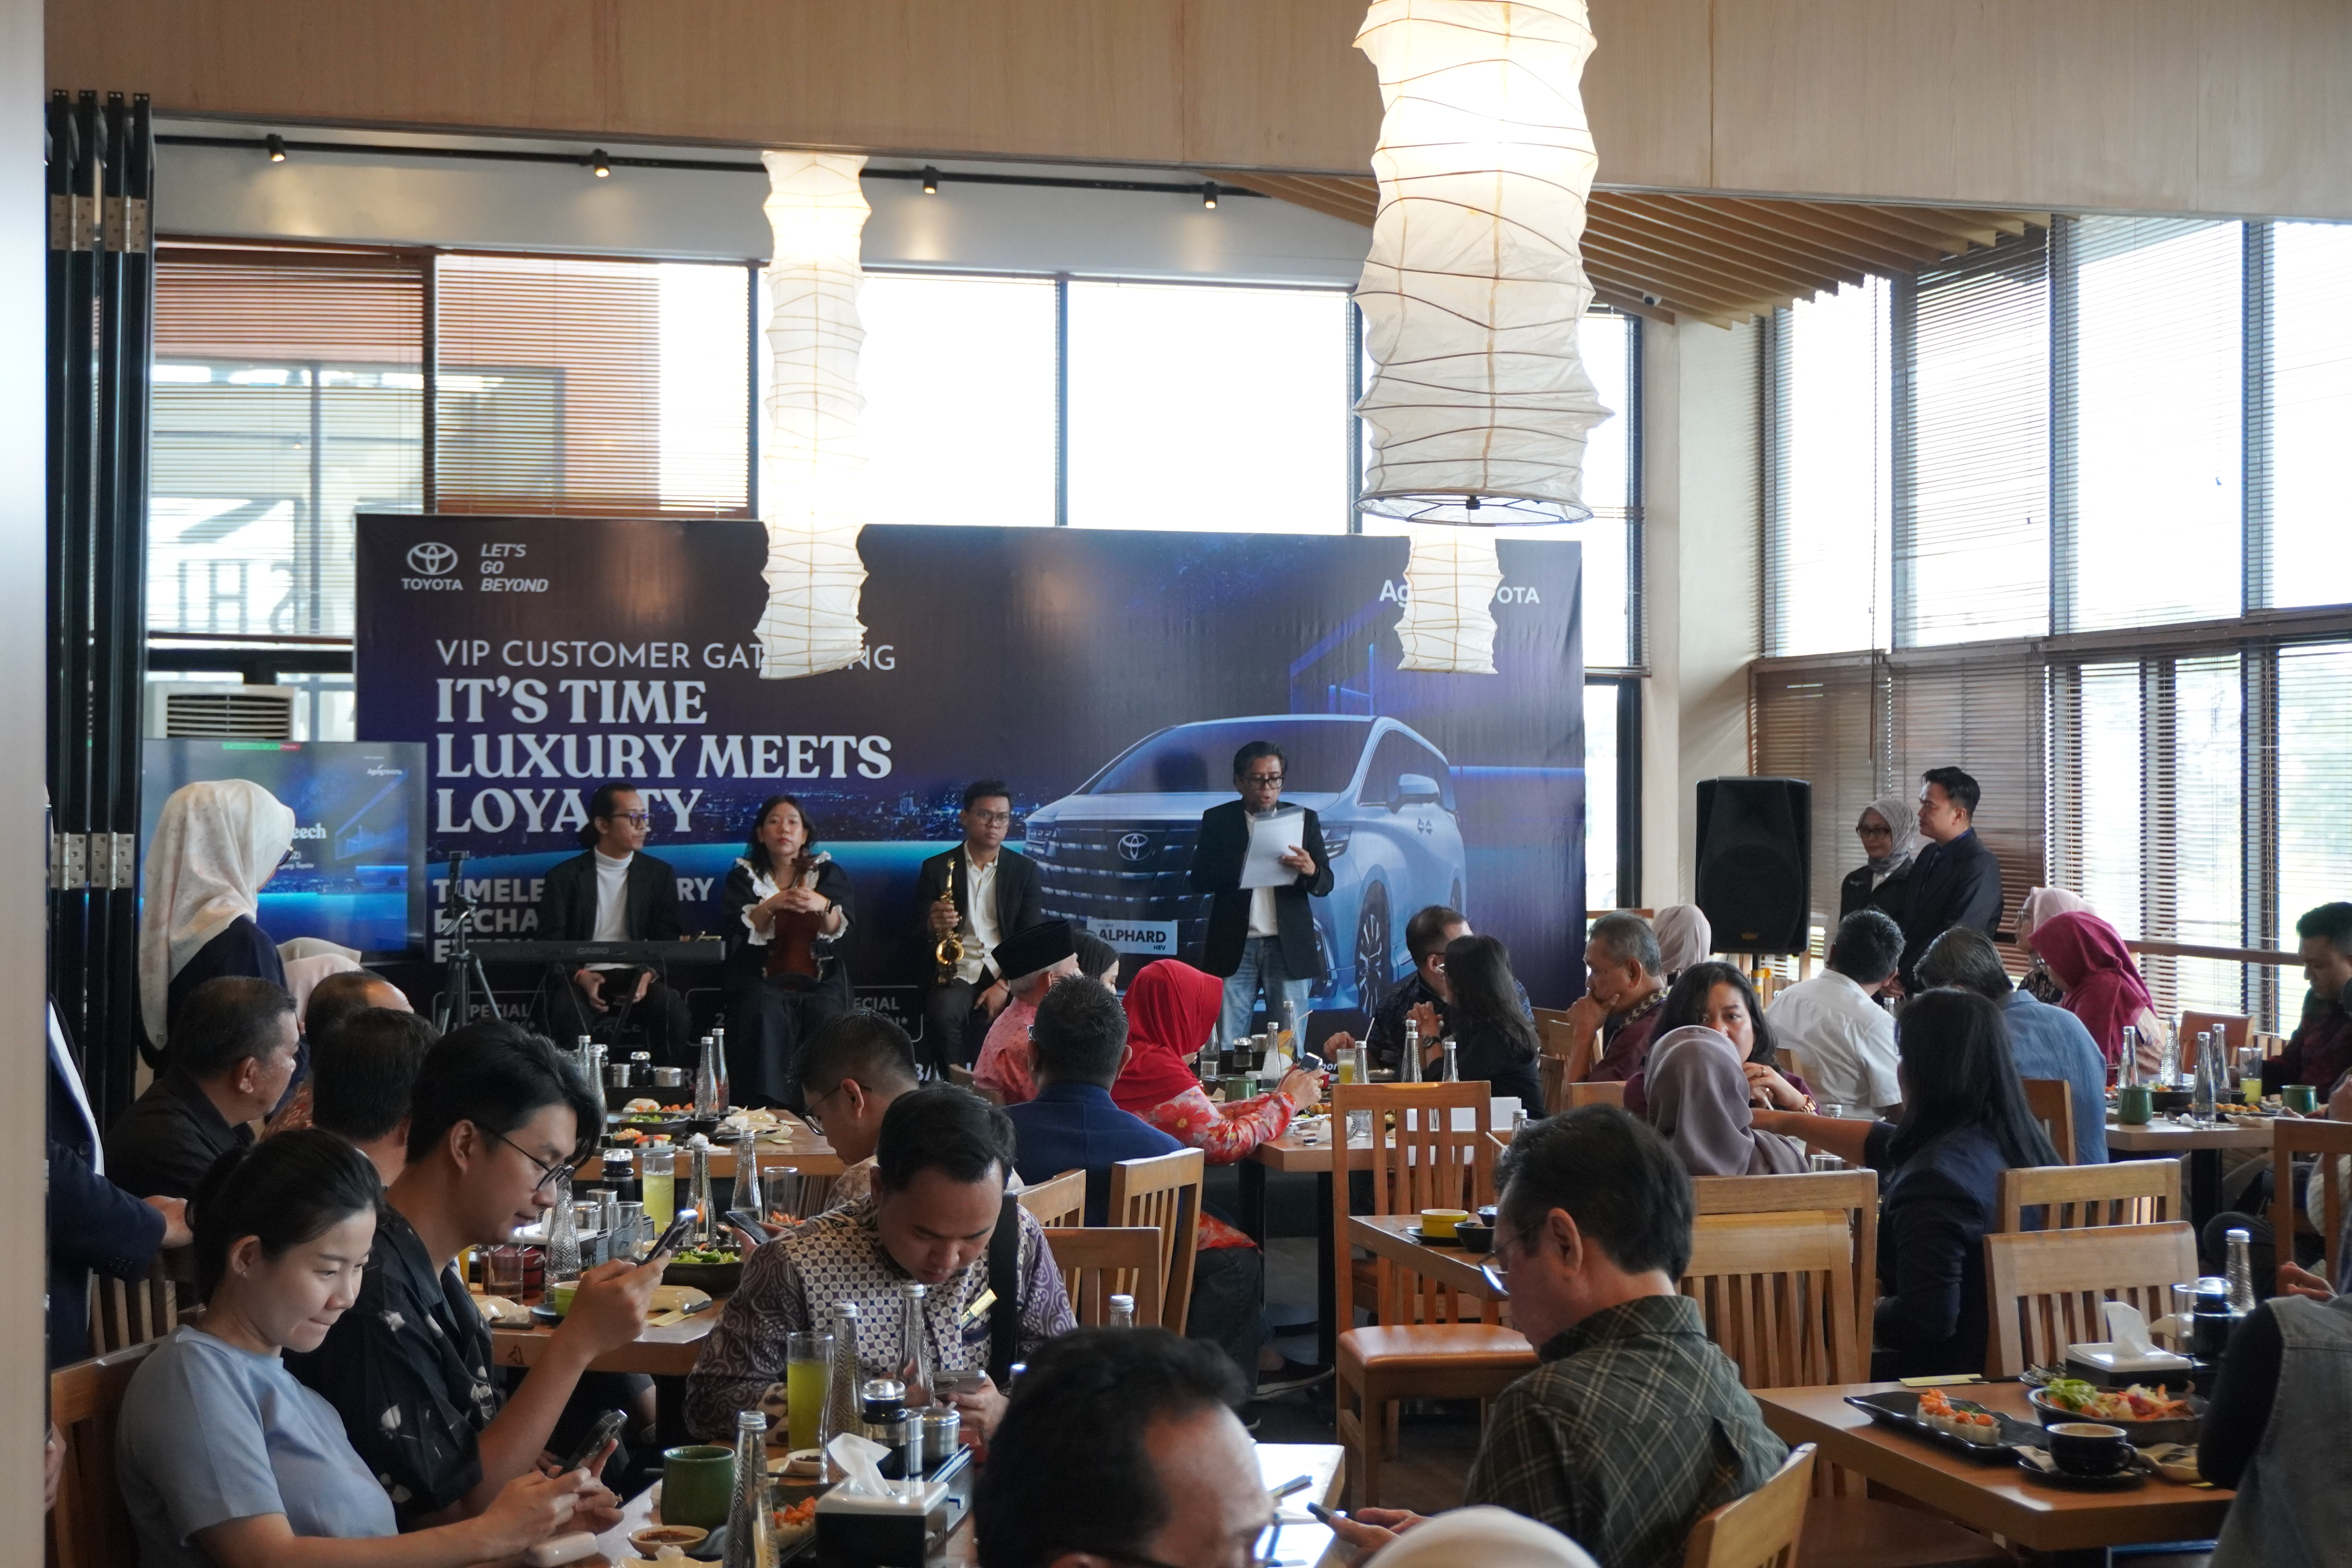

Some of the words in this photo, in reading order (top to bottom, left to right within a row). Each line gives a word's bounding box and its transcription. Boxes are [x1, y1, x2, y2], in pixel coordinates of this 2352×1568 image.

[481, 543, 527, 557] LET'S
[480, 560, 505, 575] GO
[401, 577, 464, 591] TOYOTA
[480, 578, 550, 593] BEYOND
[436, 639, 490, 666] VIP
[502, 640, 691, 668] CUSTOMER
[703, 642, 896, 671] GATNG
[436, 675, 548, 724] IT'S
[559, 679, 708, 724] TIME
[436, 733, 687, 779] LUXURY
[695, 735, 892, 779] MEETS
[436, 788, 704, 833] LOYATY
[294, 822, 327, 839] eech
[1099, 929, 1167, 943] ALPHARD
[852, 997, 900, 1010] ECIAL
